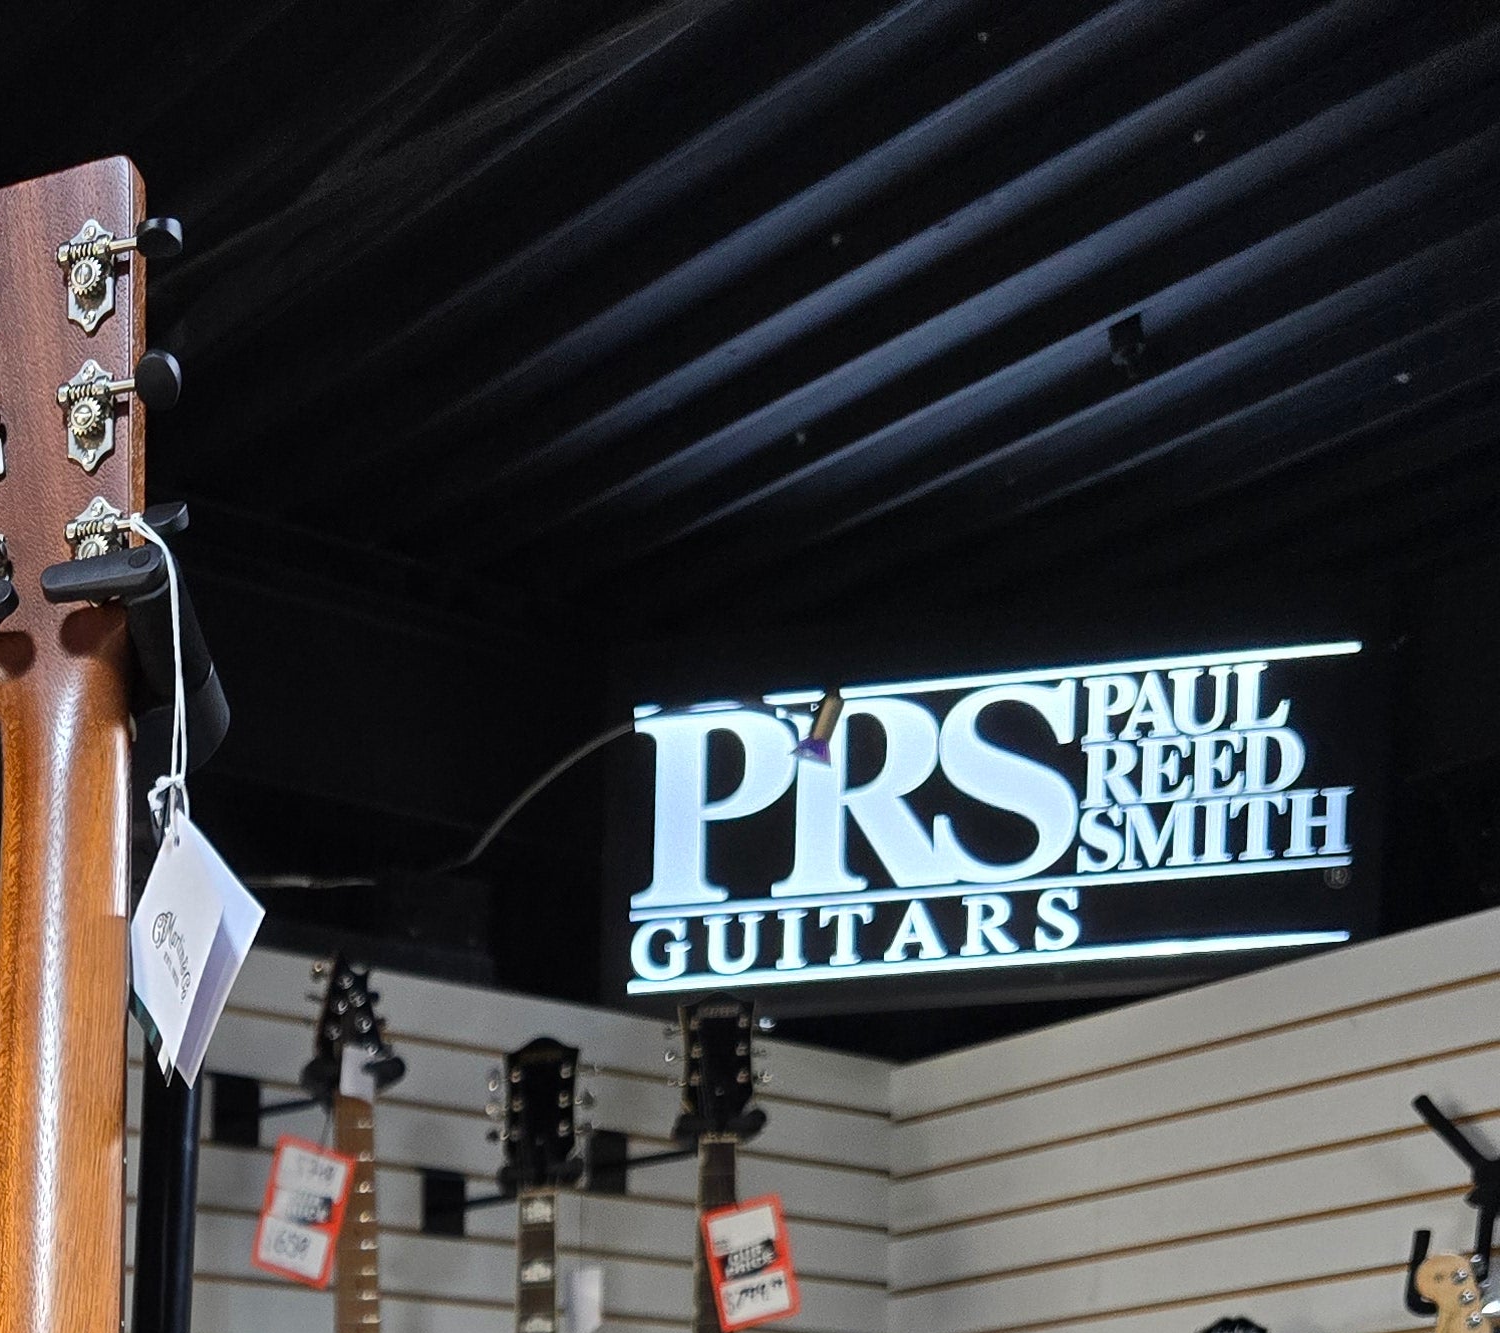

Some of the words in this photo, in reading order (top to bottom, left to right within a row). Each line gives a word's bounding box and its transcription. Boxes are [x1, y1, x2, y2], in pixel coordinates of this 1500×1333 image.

[1081, 662, 1291, 745] PAUL
[631, 680, 1078, 909] PRS
[1082, 728, 1306, 809] REED
[1077, 786, 1356, 875] SMITH
[631, 887, 1081, 981] GUITARS
